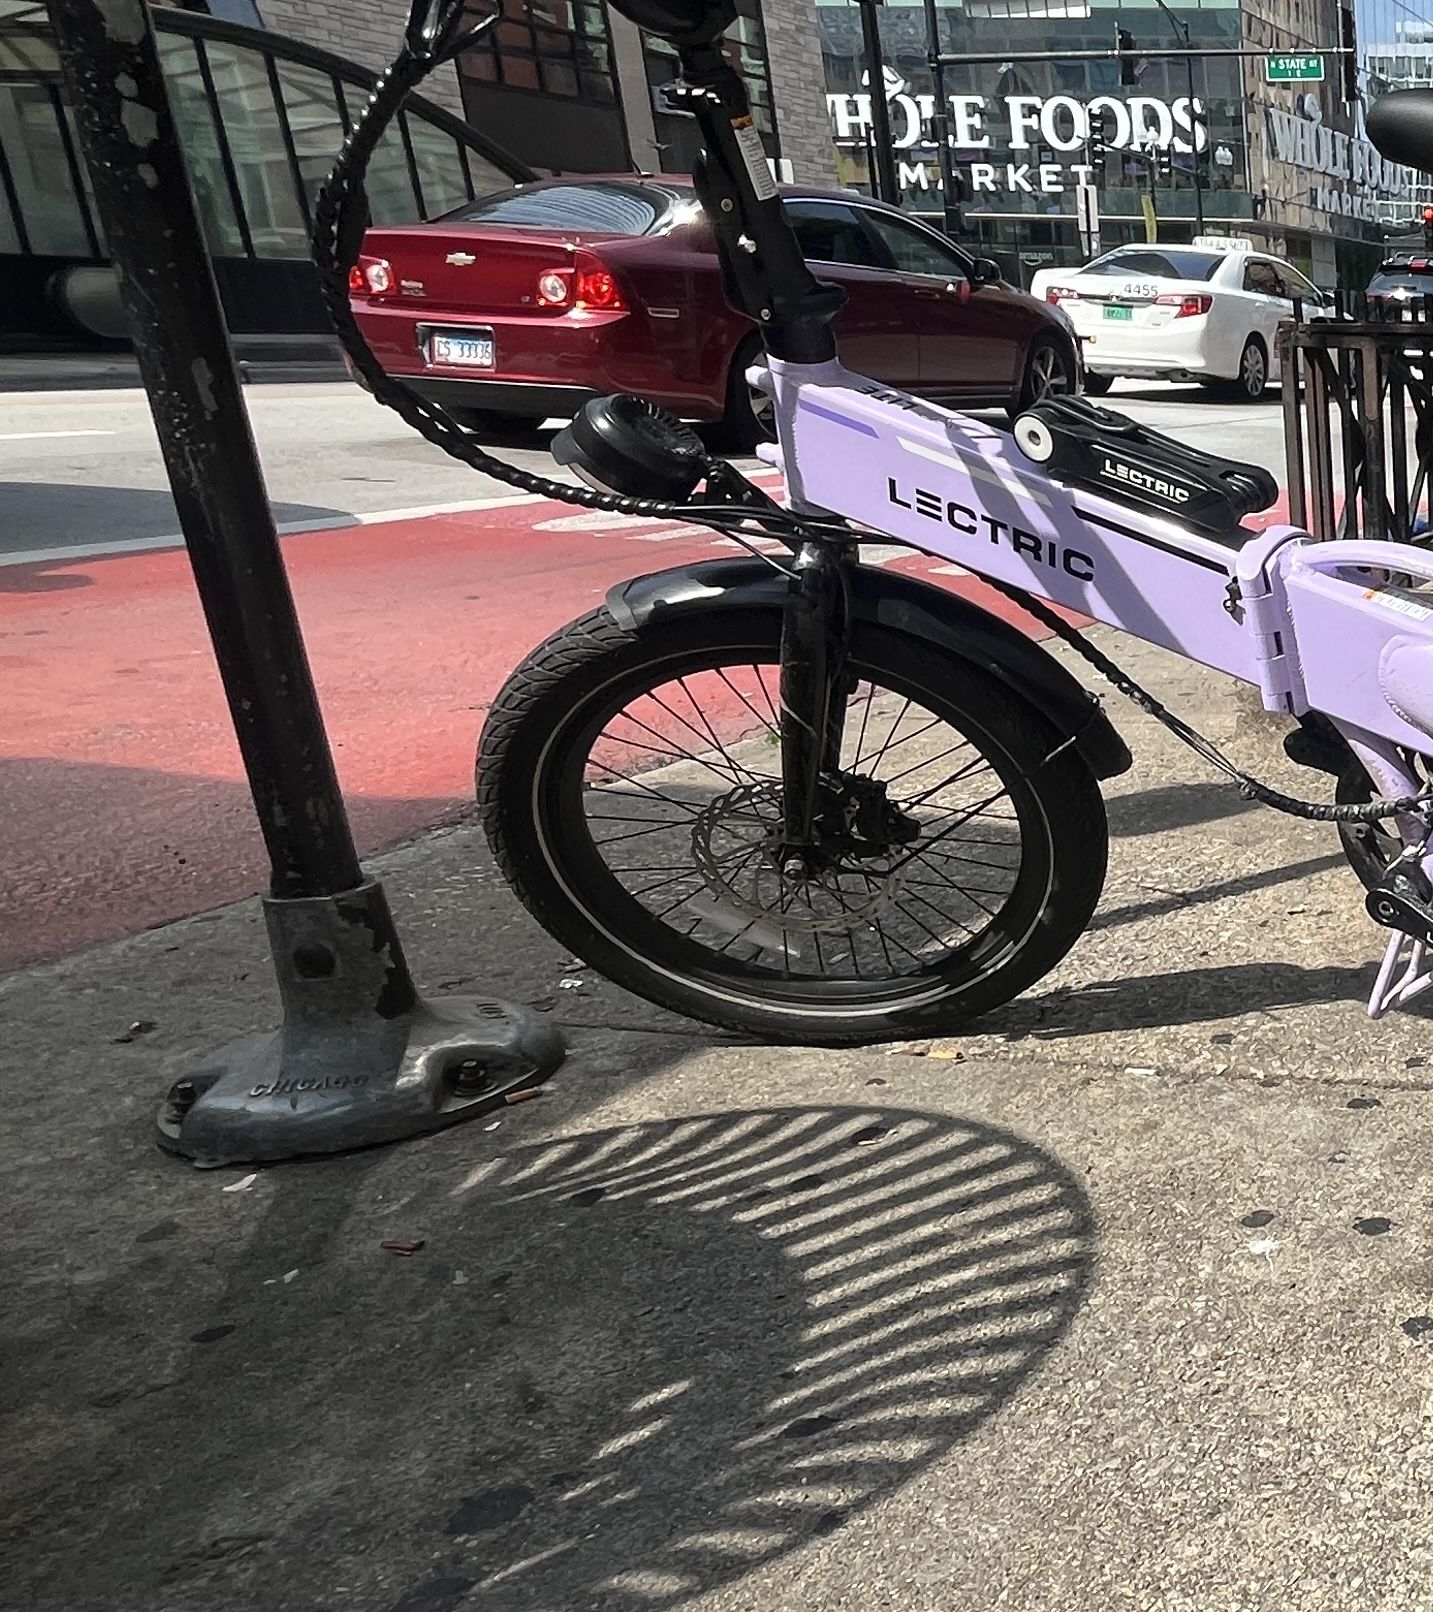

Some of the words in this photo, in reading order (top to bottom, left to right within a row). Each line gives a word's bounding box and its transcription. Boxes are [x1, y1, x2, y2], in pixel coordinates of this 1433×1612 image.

[1278, 58, 1307, 70] STATE
[826, 93, 990, 148] HOLE
[1004, 95, 1206, 153] FOODS
[1268, 107, 1350, 181] WHOLE
[900, 162, 1093, 192] MRKET
[1124, 284, 1158, 298] 4455
[437, 340, 451, 358] CS
[1105, 459, 1190, 501] LECTRIC
[888, 477, 1095, 582] LECTRIC
[250, 1074, 369, 1097] CHICAGO
